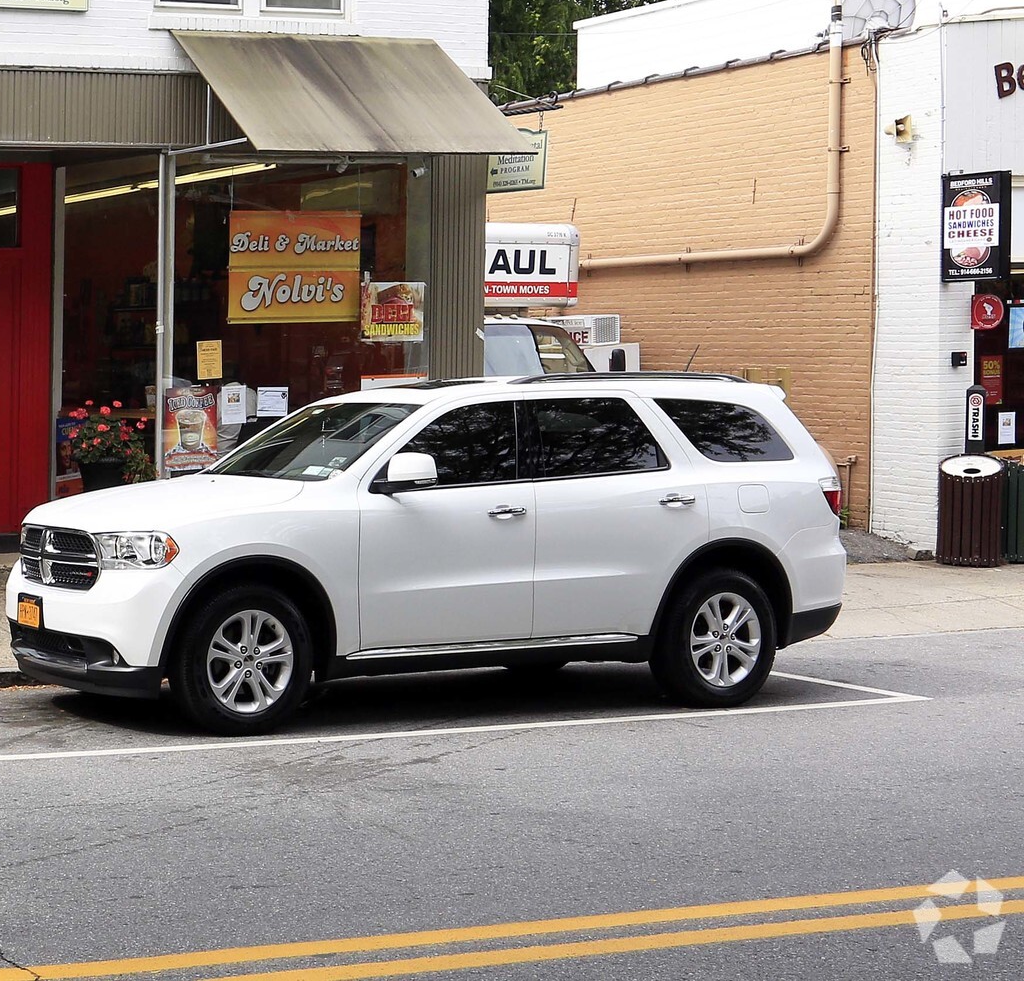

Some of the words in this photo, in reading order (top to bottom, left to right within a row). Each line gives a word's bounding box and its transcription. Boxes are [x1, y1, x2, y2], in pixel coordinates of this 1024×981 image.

[497, 154, 535, 166] Meditation
[500, 165, 530, 175] PROGRAM
[976, 177, 993, 185] HILLS
[948, 209, 968, 220] HOT
[970, 207, 994, 219] FOOD
[948, 219, 994, 230] SANDWICHES
[948, 228, 994, 239] CHEESE
[230, 231, 270, 252] Deli
[275, 234, 290, 252] &
[294, 233, 360, 254] Market
[486, 248, 557, 275] AUL
[240, 273, 345, 312] Nolvi's
[519, 285, 550, 294] MOVES
[364, 323, 419, 336] SANDWICHES
[983, 360, 1001, 370] 50%
